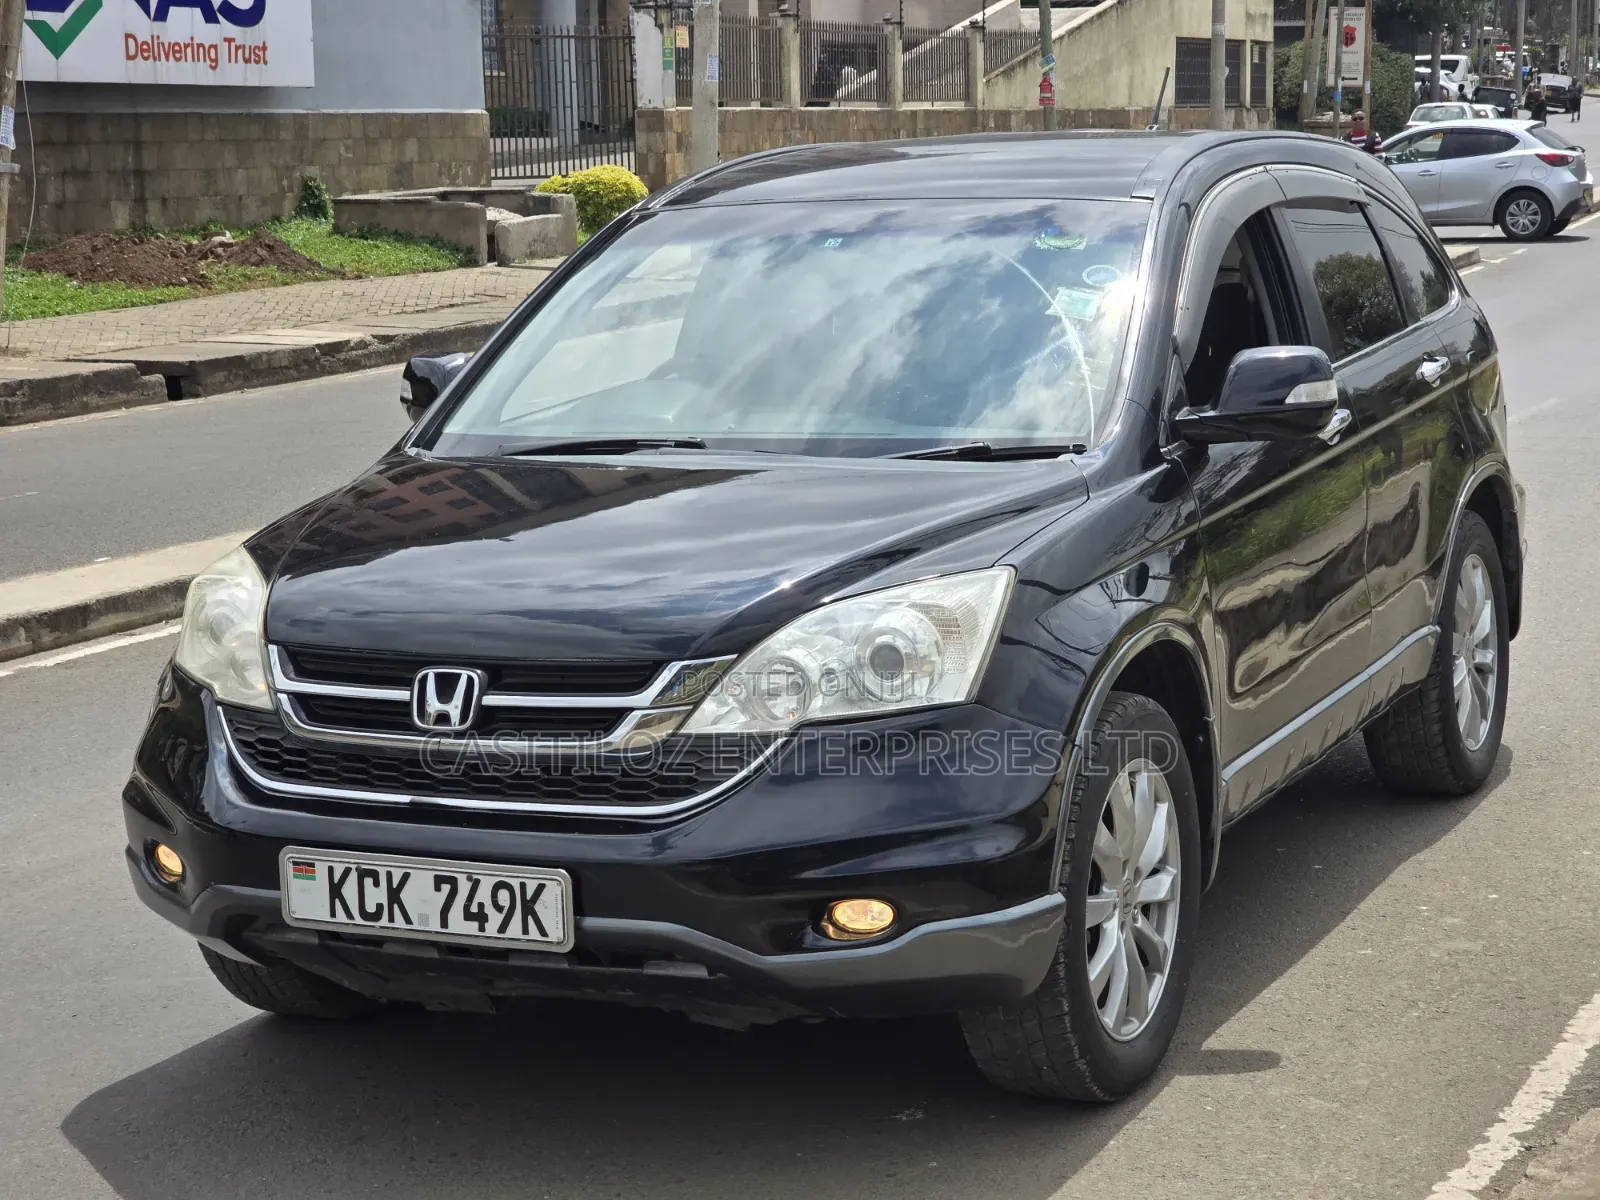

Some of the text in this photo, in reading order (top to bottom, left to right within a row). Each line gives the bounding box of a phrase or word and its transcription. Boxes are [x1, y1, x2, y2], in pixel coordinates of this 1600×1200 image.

[124, 33, 268, 71] Delivering Trust
[327, 864, 414, 926] KCK
[433, 873, 549, 938] 749K
